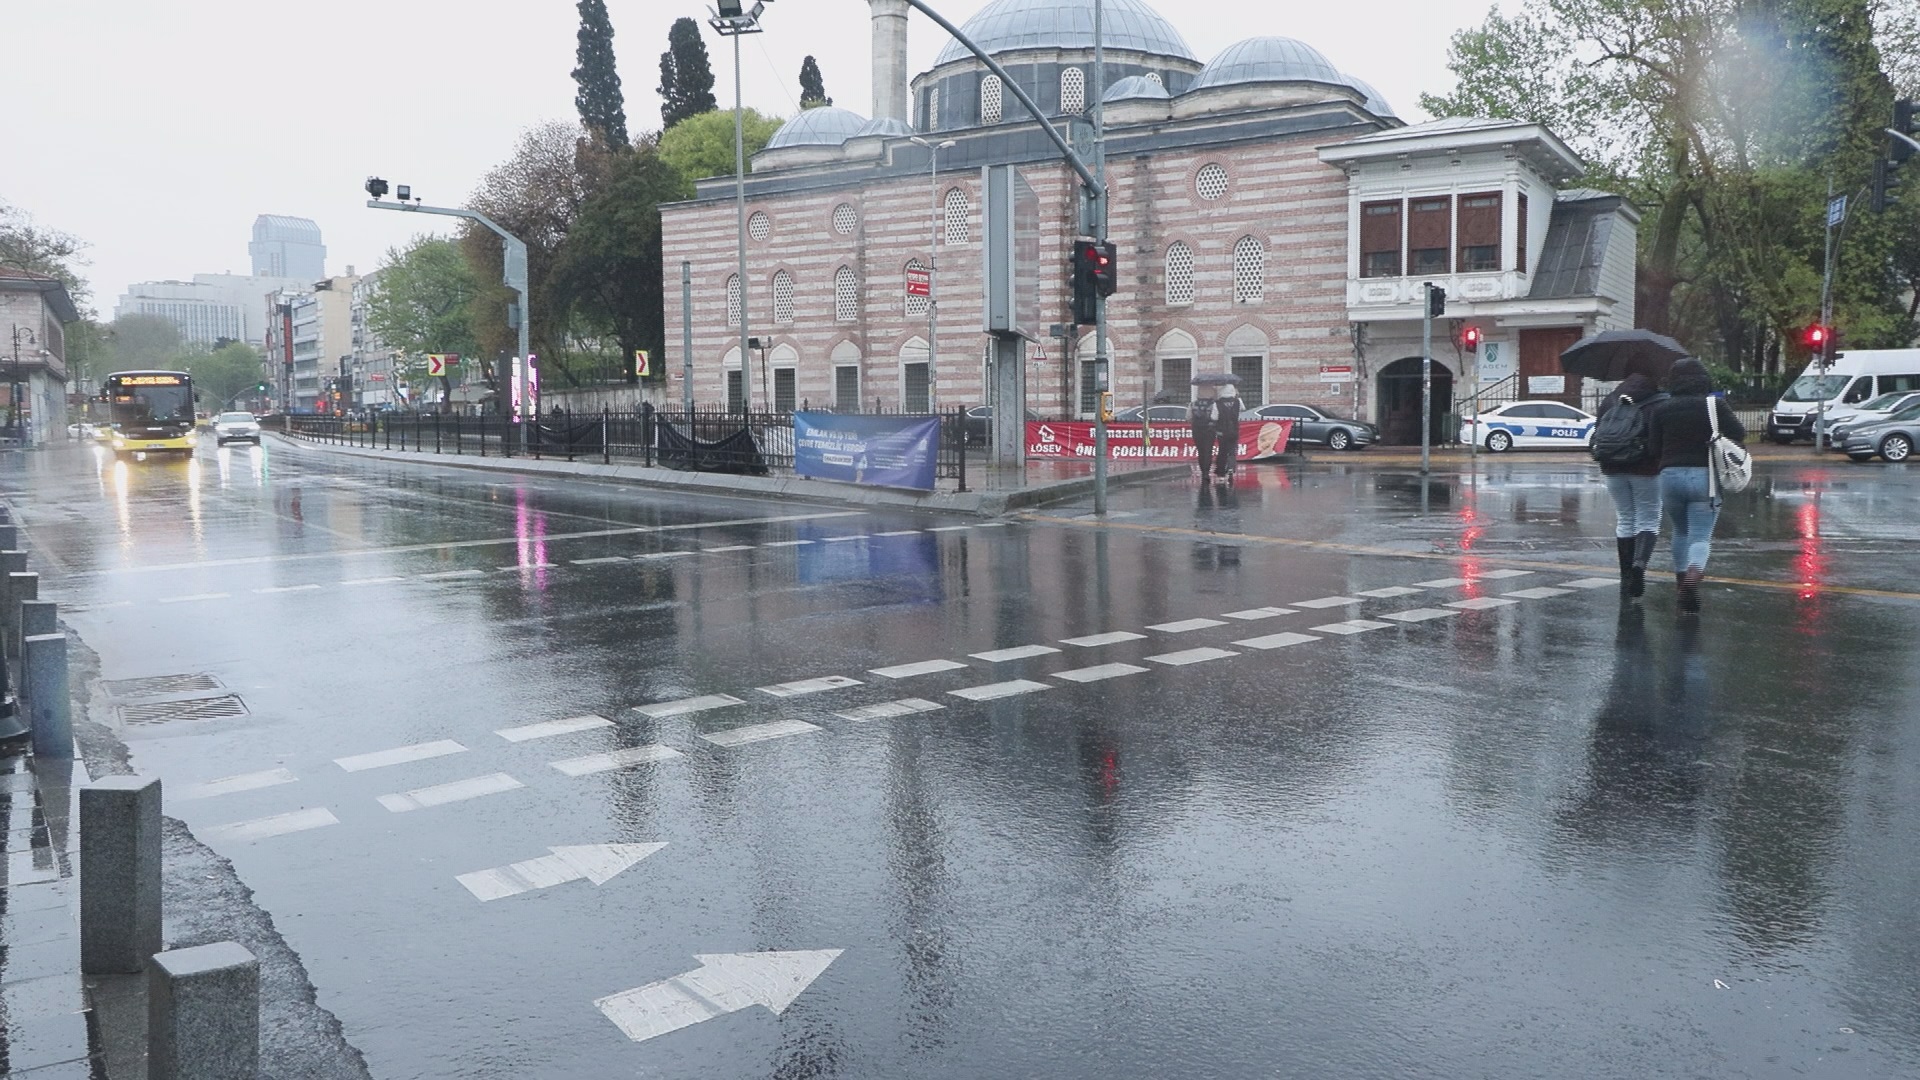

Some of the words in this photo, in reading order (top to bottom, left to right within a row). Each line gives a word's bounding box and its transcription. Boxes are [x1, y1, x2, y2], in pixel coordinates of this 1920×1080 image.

[1089, 427, 1143, 439] Rmazan
[1148, 427, 1193, 441] Bağışla
[1551, 428, 1579, 437] POLİS
[1030, 443, 1062, 453] LÖSEV
[1075, 443, 1096, 456] ÖN
[1112, 445, 1179, 459] ÇOCUKLAR
